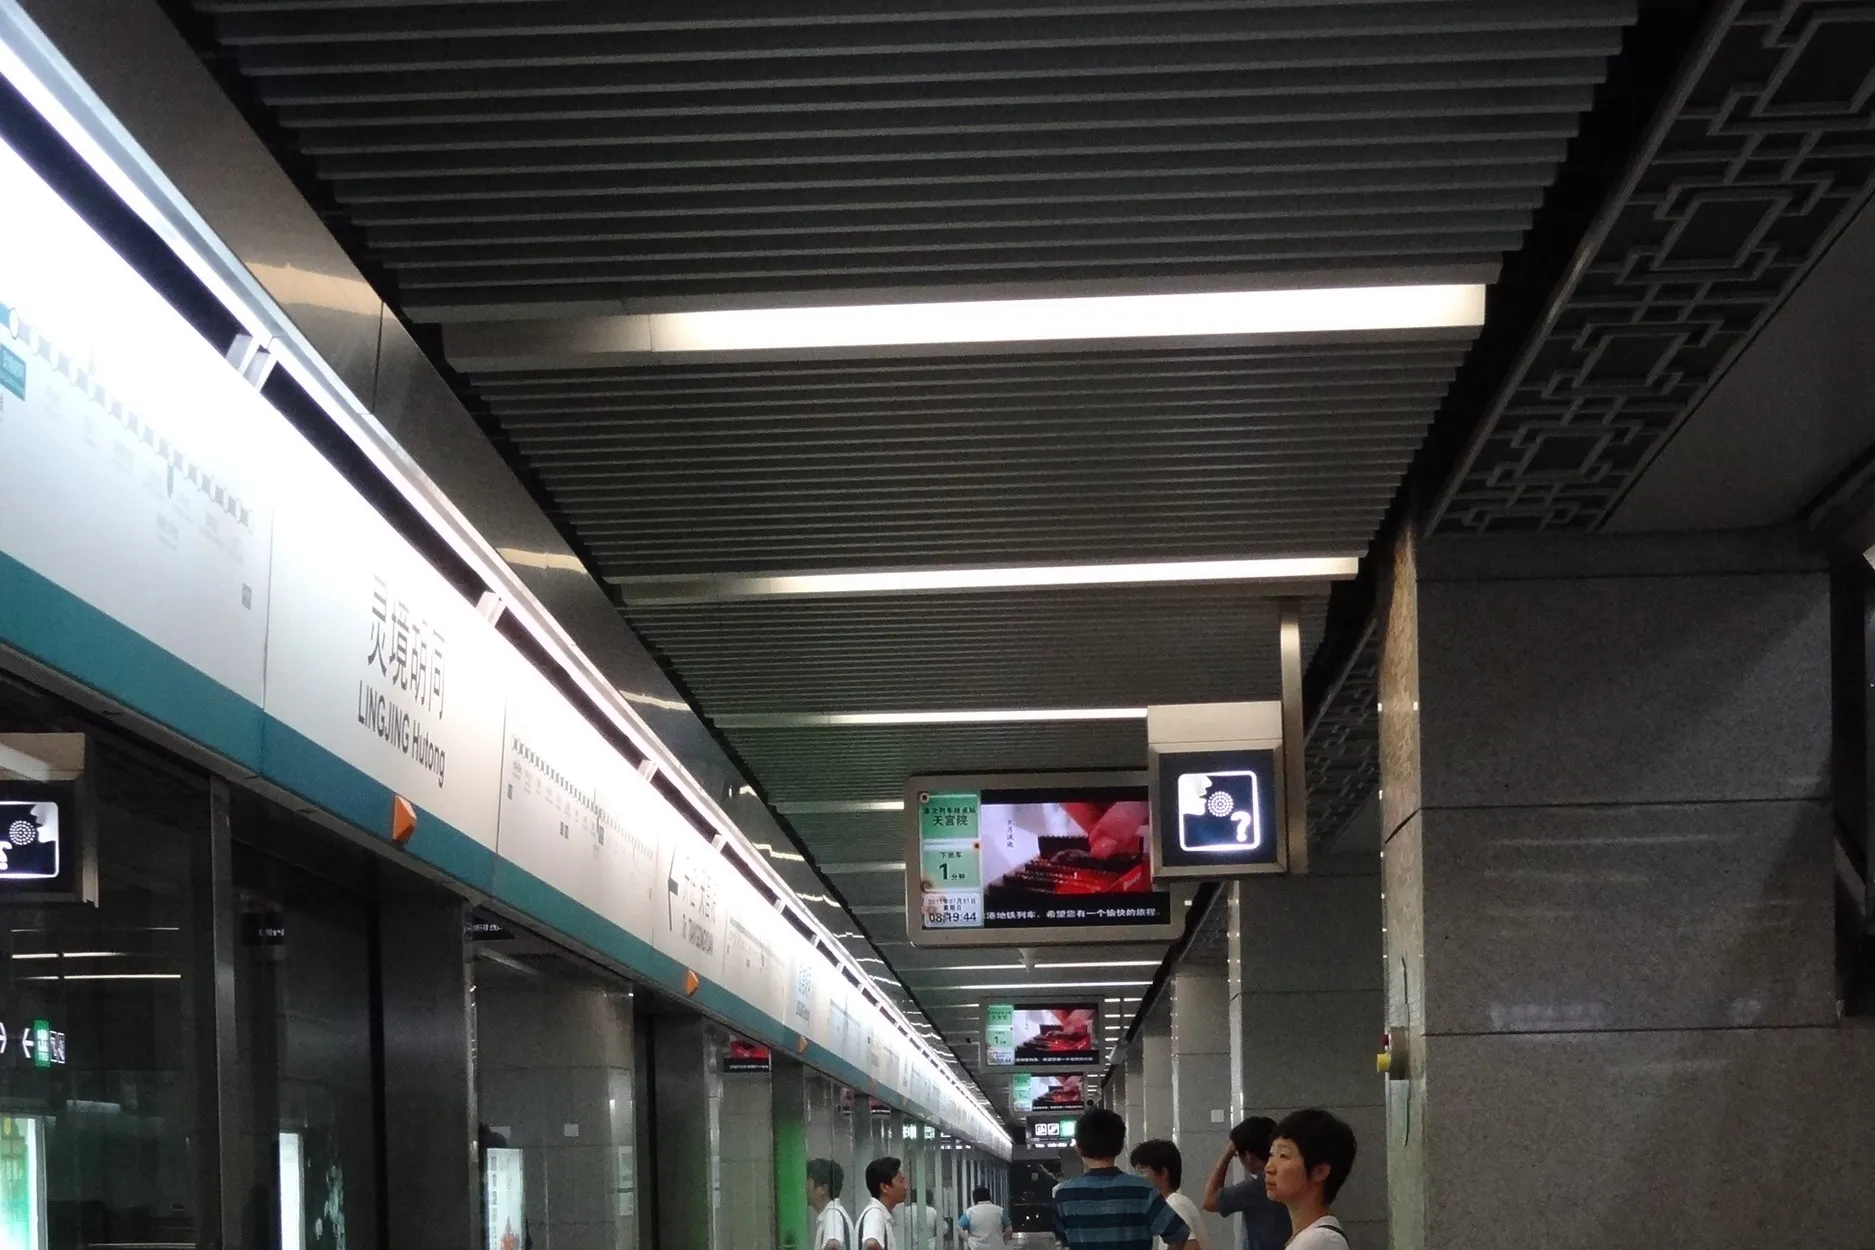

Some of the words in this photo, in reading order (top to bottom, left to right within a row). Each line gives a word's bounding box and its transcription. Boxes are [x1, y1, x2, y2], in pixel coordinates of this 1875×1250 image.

[367, 574, 446, 720] 灵境胡同
[357, 680, 410, 754] LINGJING
[412, 719, 446, 789] Hutong
[933, 815, 968, 827] 天宫院
[939, 863, 948, 880] 1
[928, 912, 977, 923] 08:19:44
